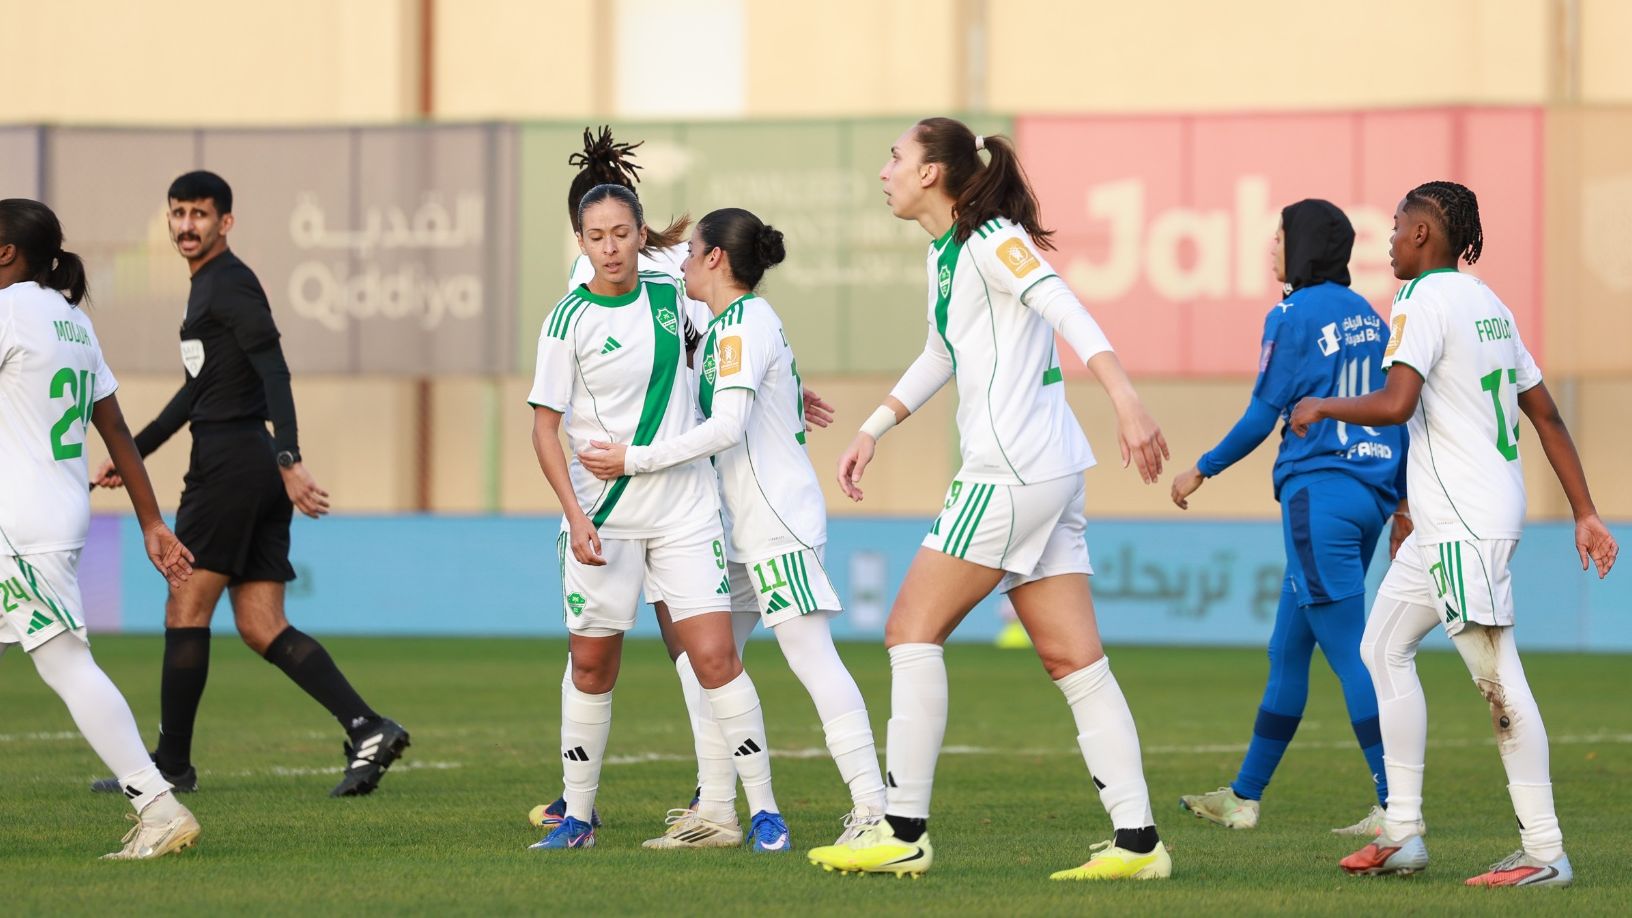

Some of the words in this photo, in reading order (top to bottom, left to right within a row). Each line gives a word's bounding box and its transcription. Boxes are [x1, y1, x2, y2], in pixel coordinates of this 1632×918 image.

[288, 261, 483, 331] Qiddiya
[712, 539, 726, 570] 9
[753, 558, 787, 594] 11
[0, 576, 32, 613] 24
